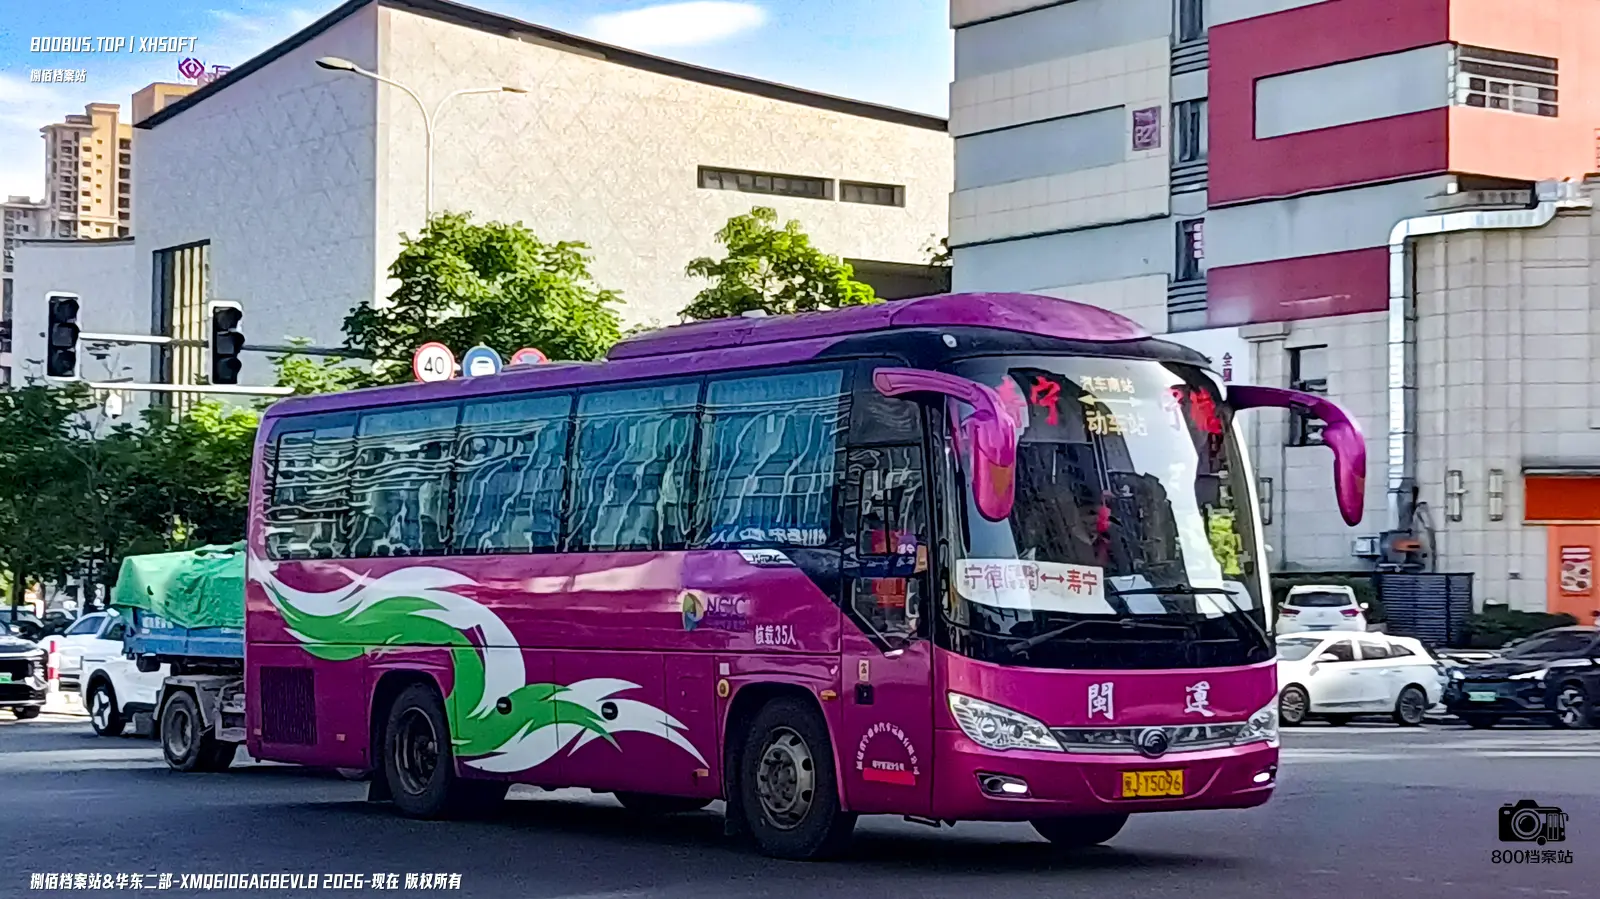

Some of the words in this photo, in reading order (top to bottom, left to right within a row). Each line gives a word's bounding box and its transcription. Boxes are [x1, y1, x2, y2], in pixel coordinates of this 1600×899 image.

[424, 356, 445, 375] 40
[1085, 410, 1149, 436] 动车站
[1066, 569, 1098, 596] 寿宁
[755, 624, 797, 646] 核载35人
